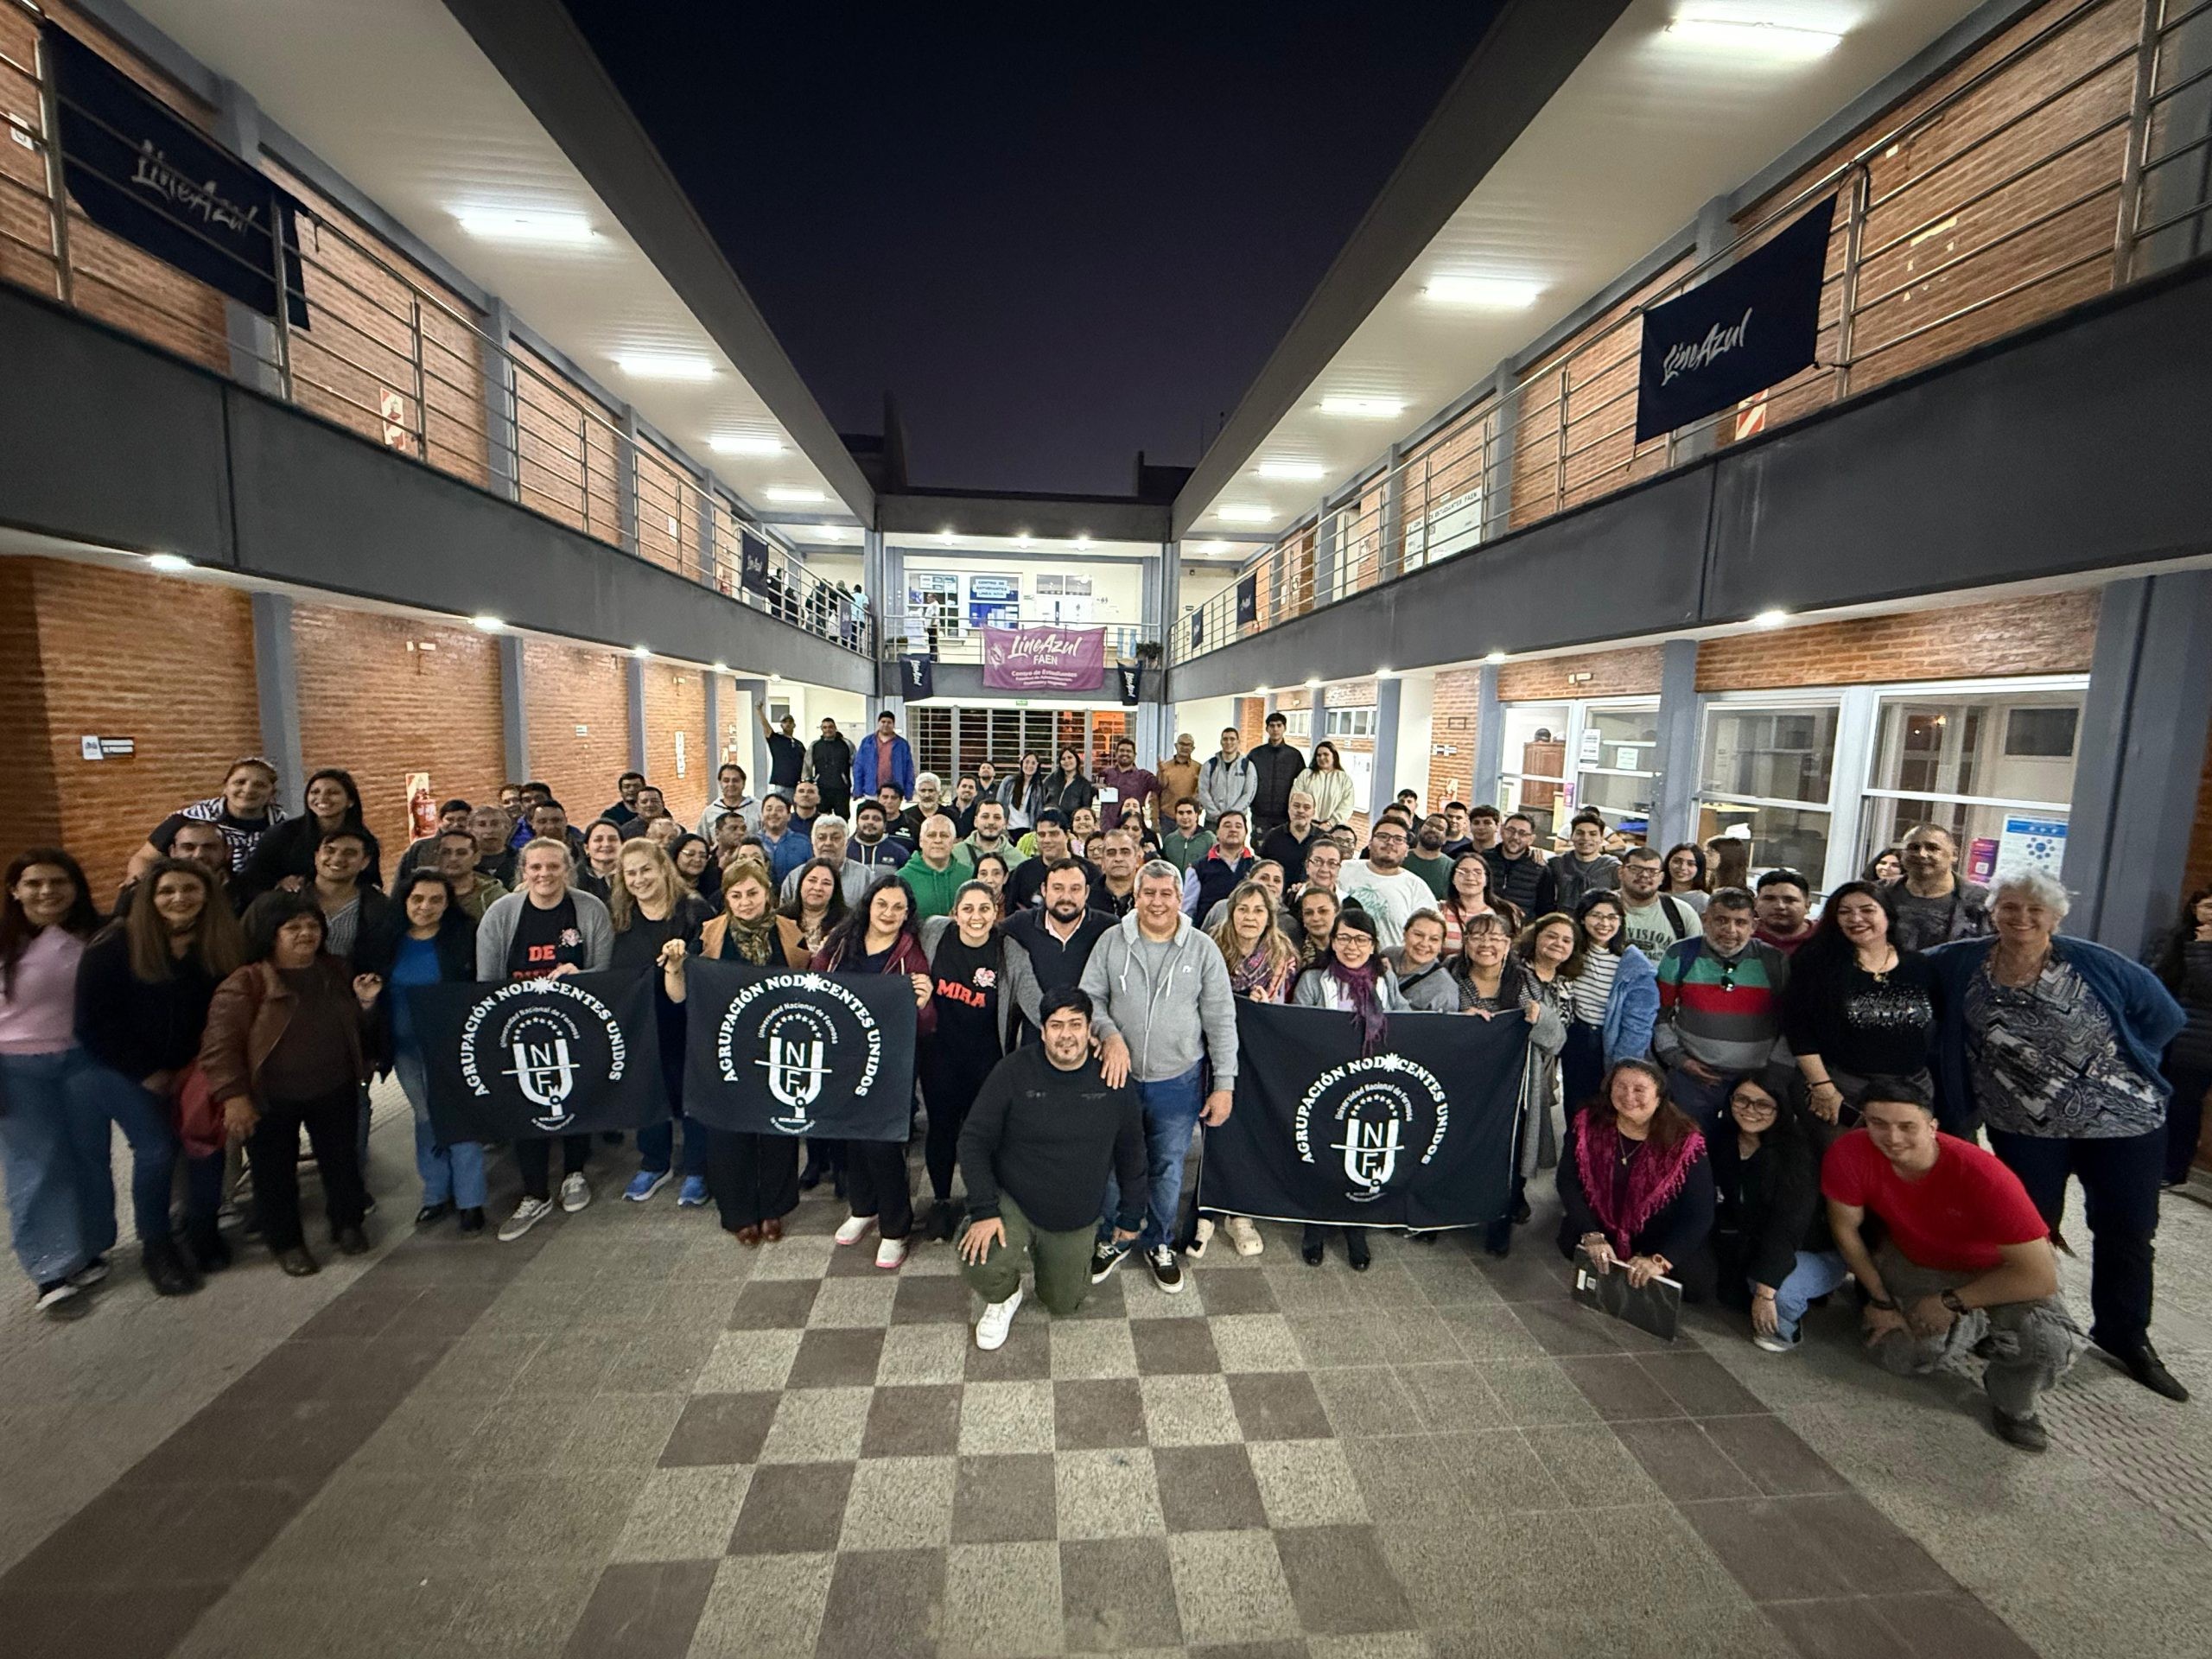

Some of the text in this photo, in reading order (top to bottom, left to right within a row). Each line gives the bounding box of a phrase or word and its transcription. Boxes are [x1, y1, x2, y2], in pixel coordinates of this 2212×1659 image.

[1007, 633, 1083, 659] LineAzul
[1033, 654, 1058, 665] FAEN
[528, 944, 556, 962] DE
[937, 978, 986, 1007] MIRA
[461, 977, 626, 1097] AGRUPACIÓN NODCENTES UNIDOS
[718, 973, 881, 1097] AGRUPACIÓN NODCENTES UNIDOS
[1295, 1053, 1451, 1166] AGRUPACIÓN NODCENTES UNIDOS
